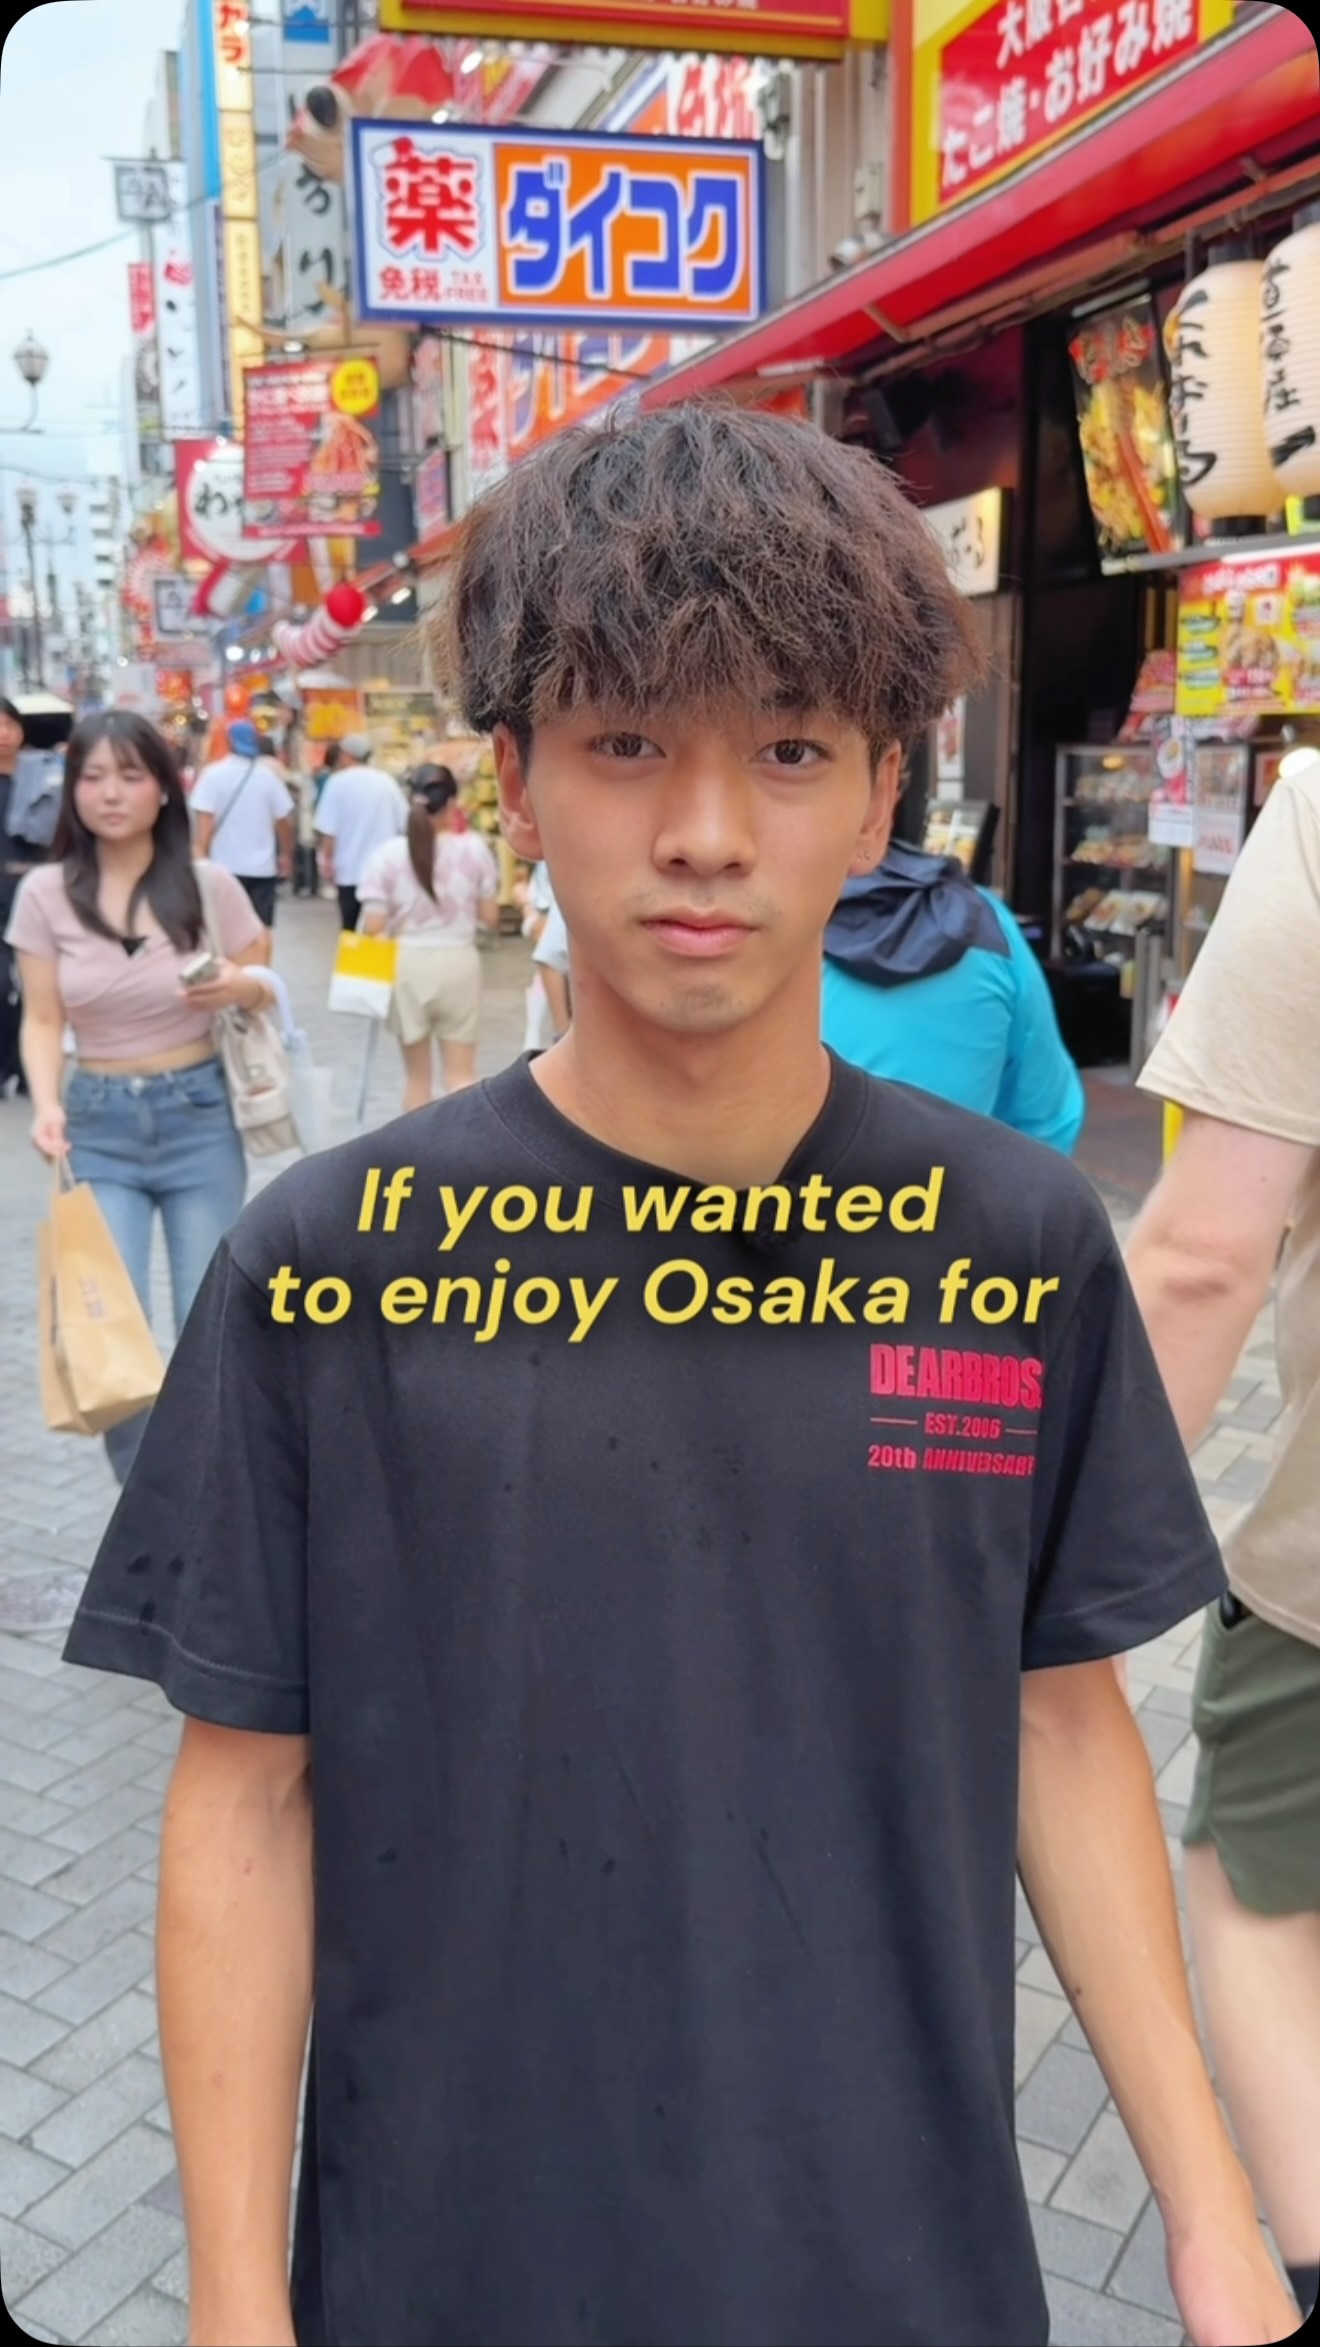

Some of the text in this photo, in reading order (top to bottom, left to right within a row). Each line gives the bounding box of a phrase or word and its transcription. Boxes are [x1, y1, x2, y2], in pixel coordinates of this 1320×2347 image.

[386, 136, 476, 253] 薬
[505, 154, 745, 300] ダイコク
[868, 1444, 918, 1469] 20th
